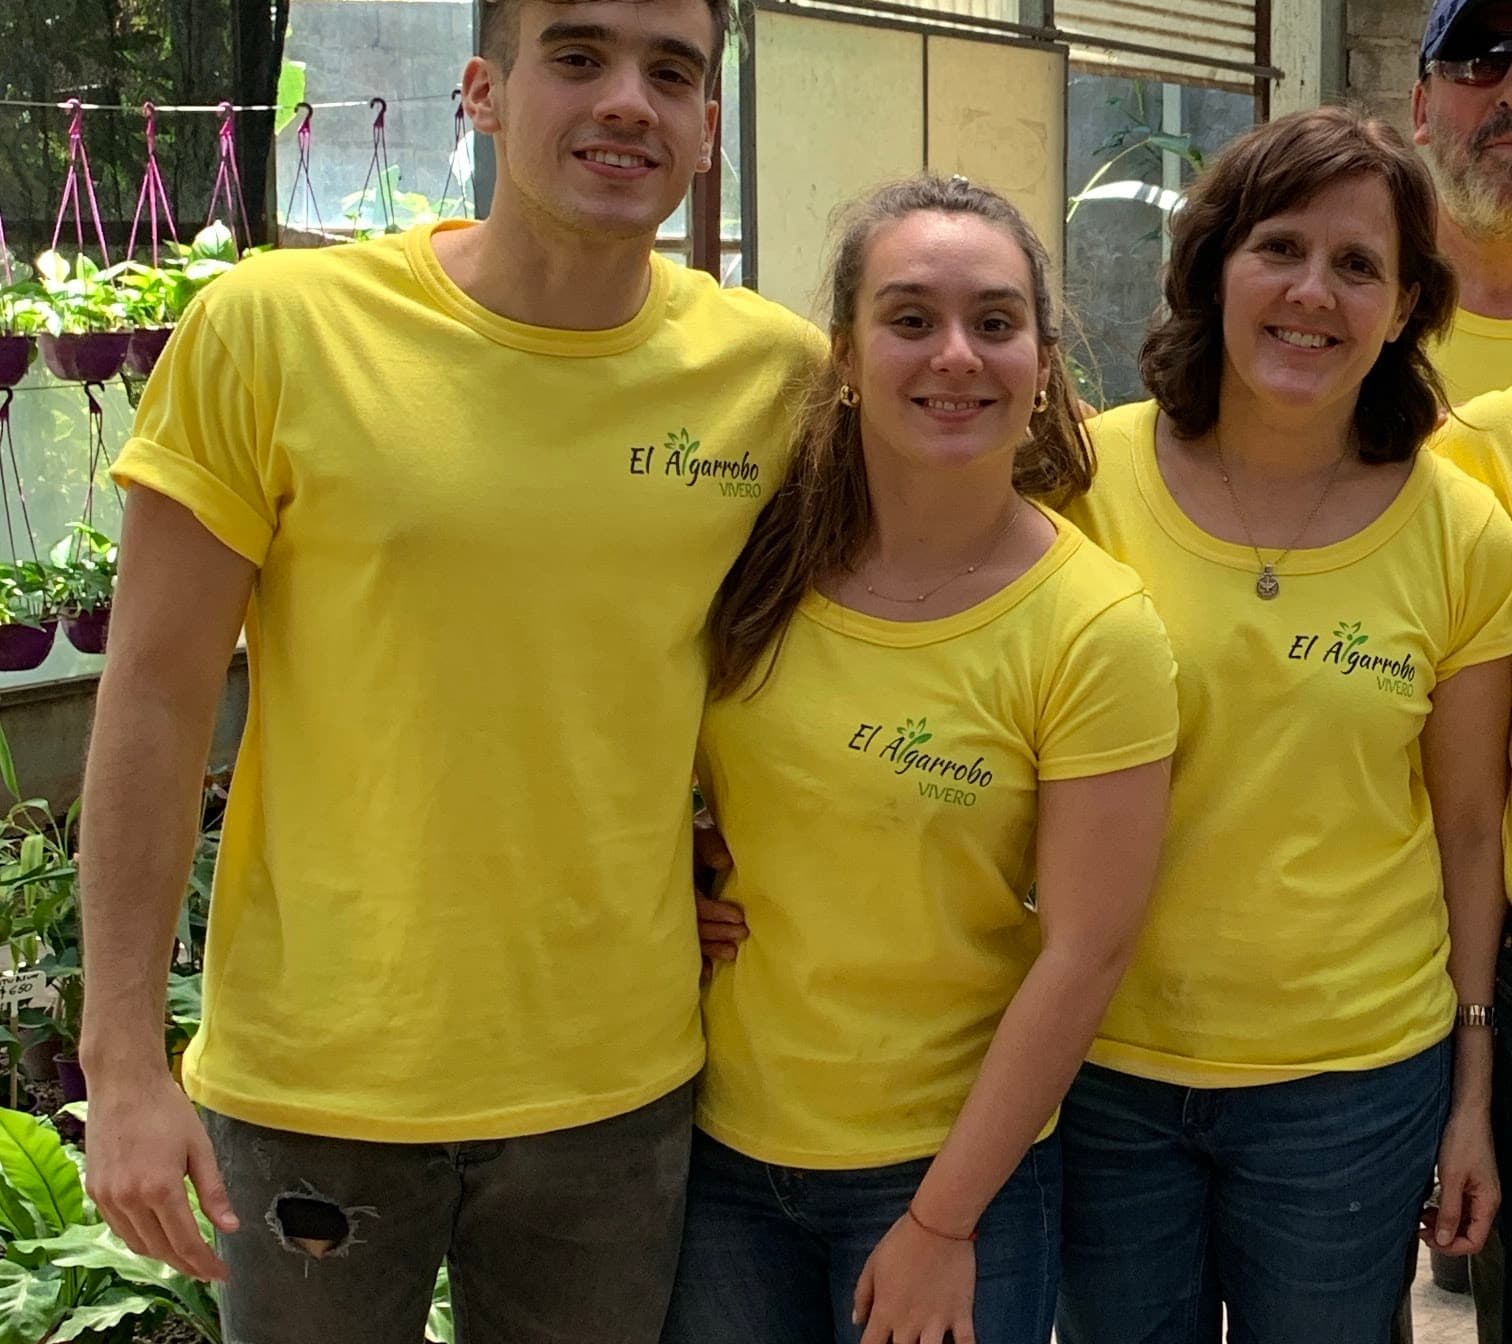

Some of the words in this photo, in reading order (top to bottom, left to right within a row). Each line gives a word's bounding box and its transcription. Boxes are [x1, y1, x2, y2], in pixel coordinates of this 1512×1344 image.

[630, 446, 655, 474] El
[665, 441, 759, 486] Algarrobo
[719, 483, 761, 498] VIVERO
[1288, 635, 1318, 660] El
[1323, 635, 1415, 682] Algarrobo
[1376, 676, 1414, 697] VIVERO
[848, 723, 882, 752] El
[879, 733, 993, 788] Algarrobo
[918, 781, 977, 807] VIVERO
